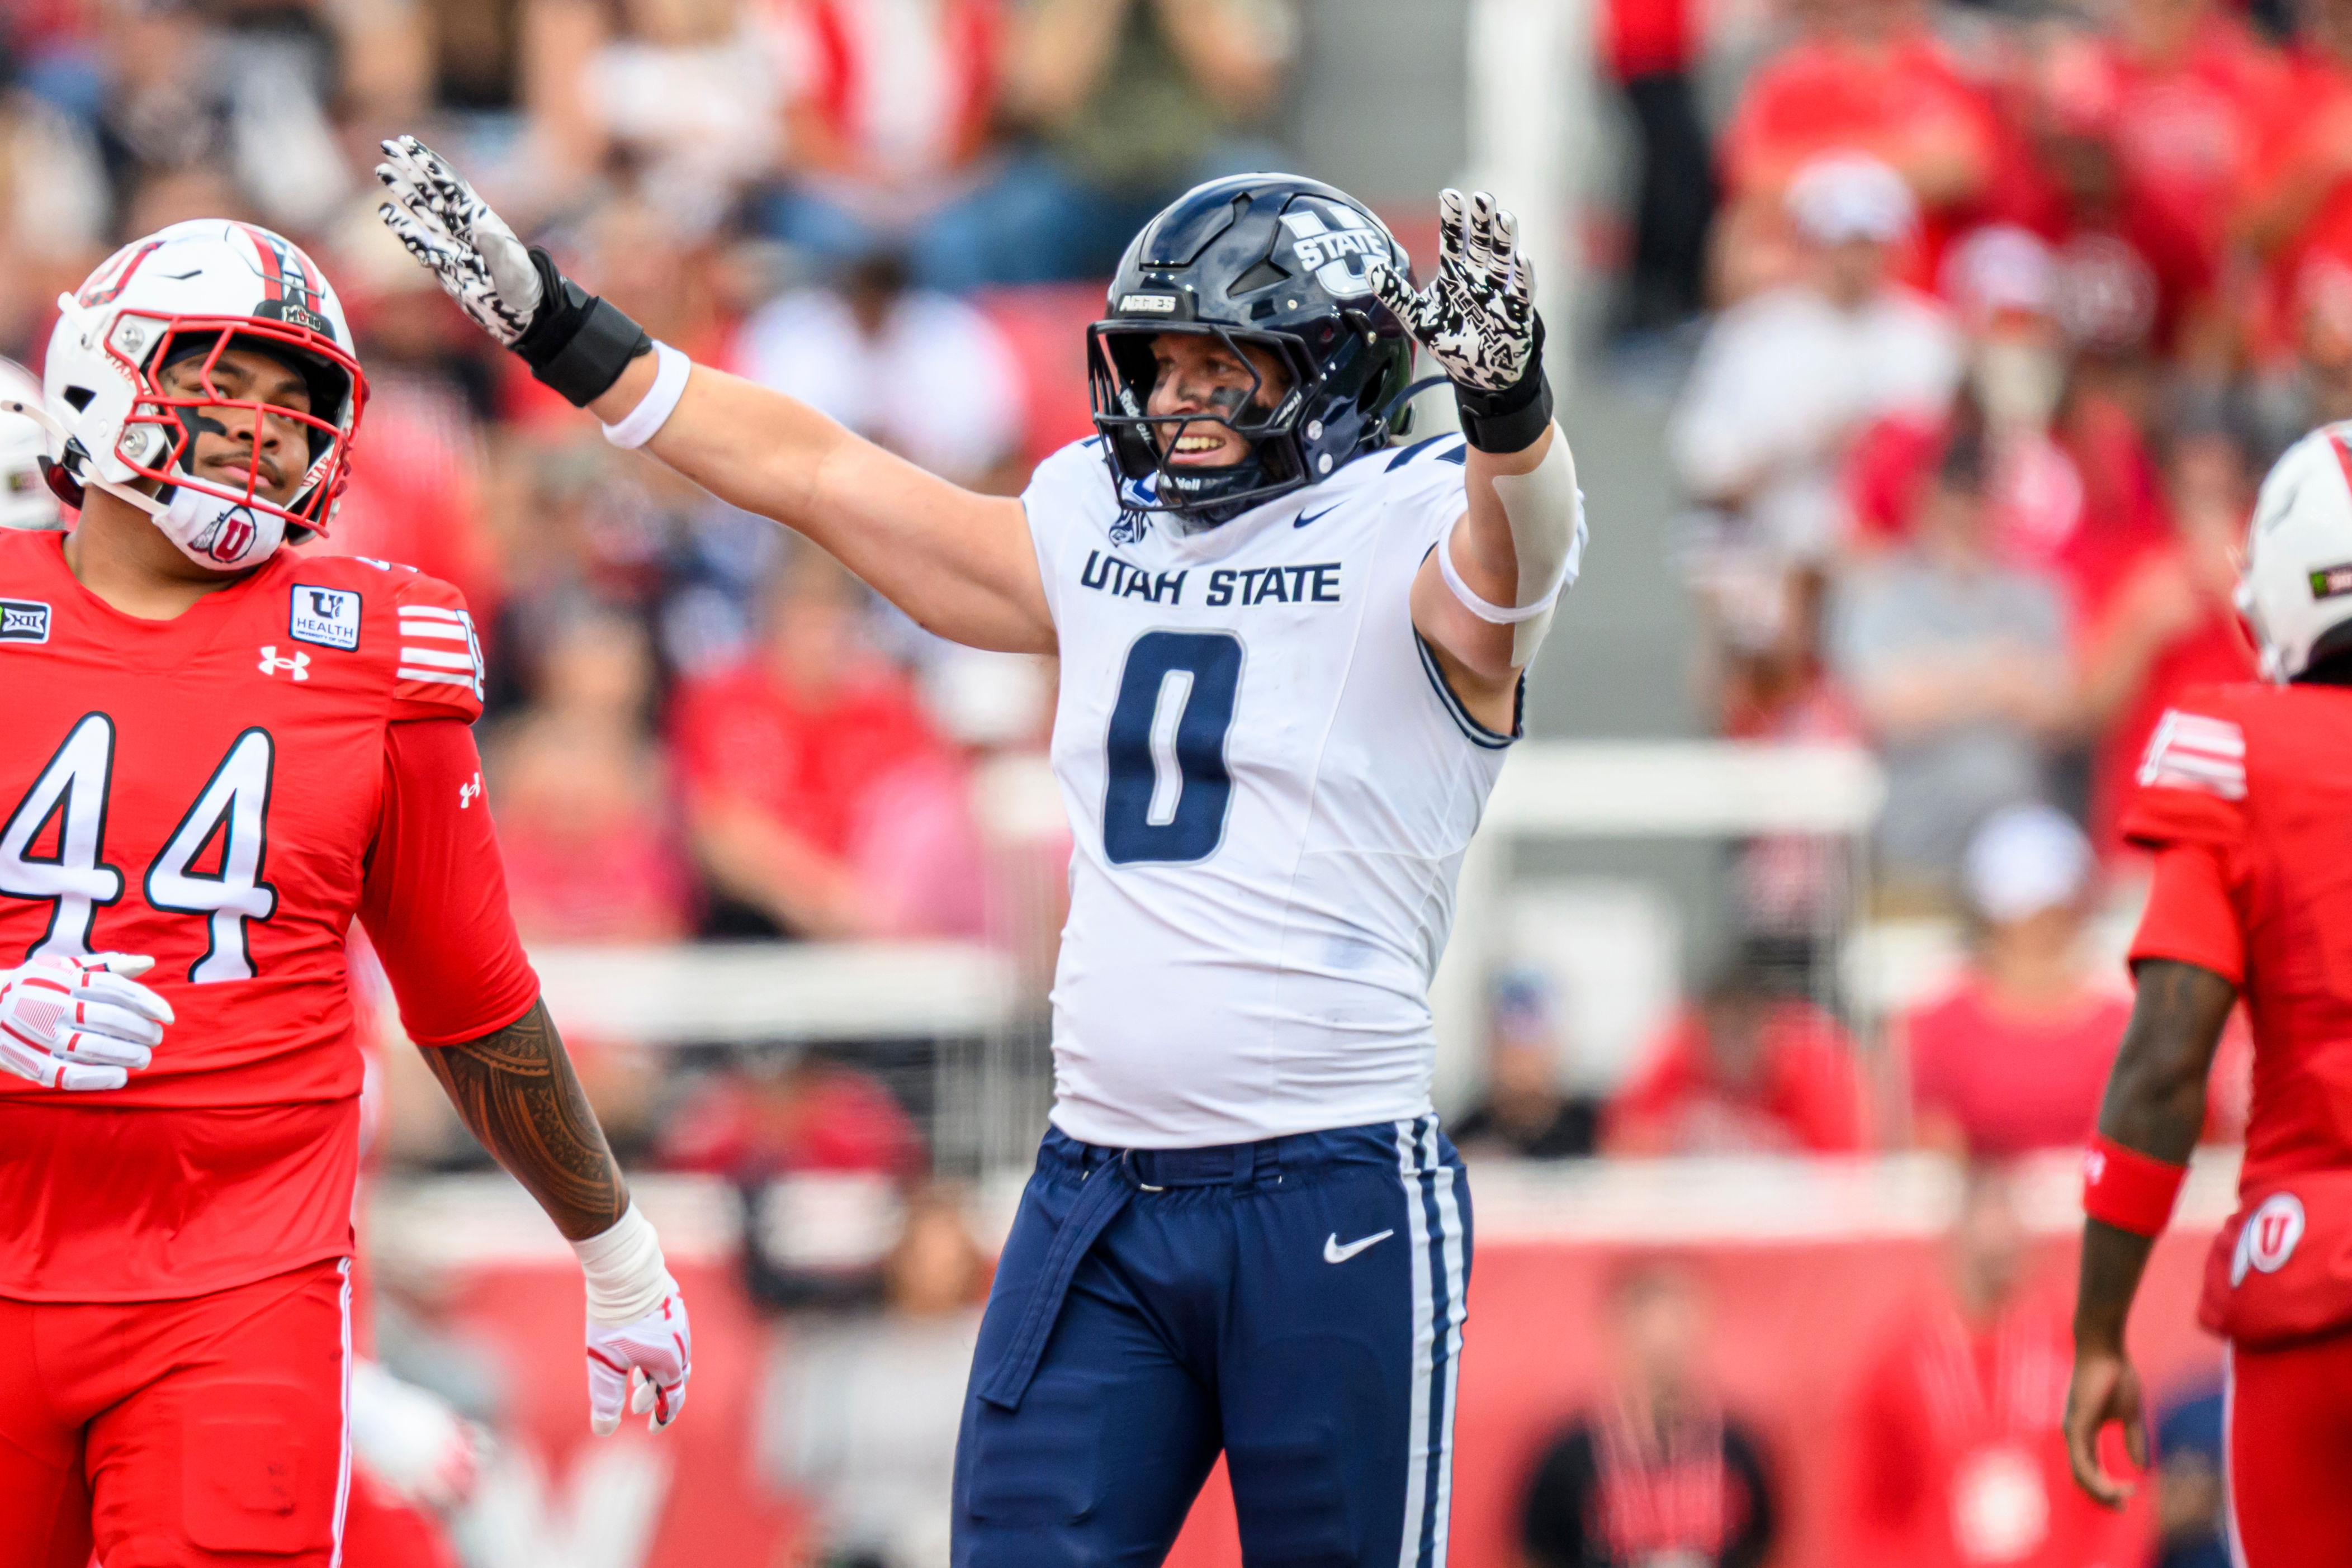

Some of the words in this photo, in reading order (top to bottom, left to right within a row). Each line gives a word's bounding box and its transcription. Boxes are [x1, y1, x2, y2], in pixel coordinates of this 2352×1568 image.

[1293, 229, 1390, 272] STATE
[1119, 295, 1176, 312] AGGIES
[215, 517, 253, 561] U
[1080, 549, 1189, 605] UTAH
[1206, 561, 1342, 607] STATE
[297, 617, 353, 638] HEALTH
[1102, 624, 1248, 871] 0
[0, 710, 278, 984] 44
[2260, 1213, 2293, 1257] U
